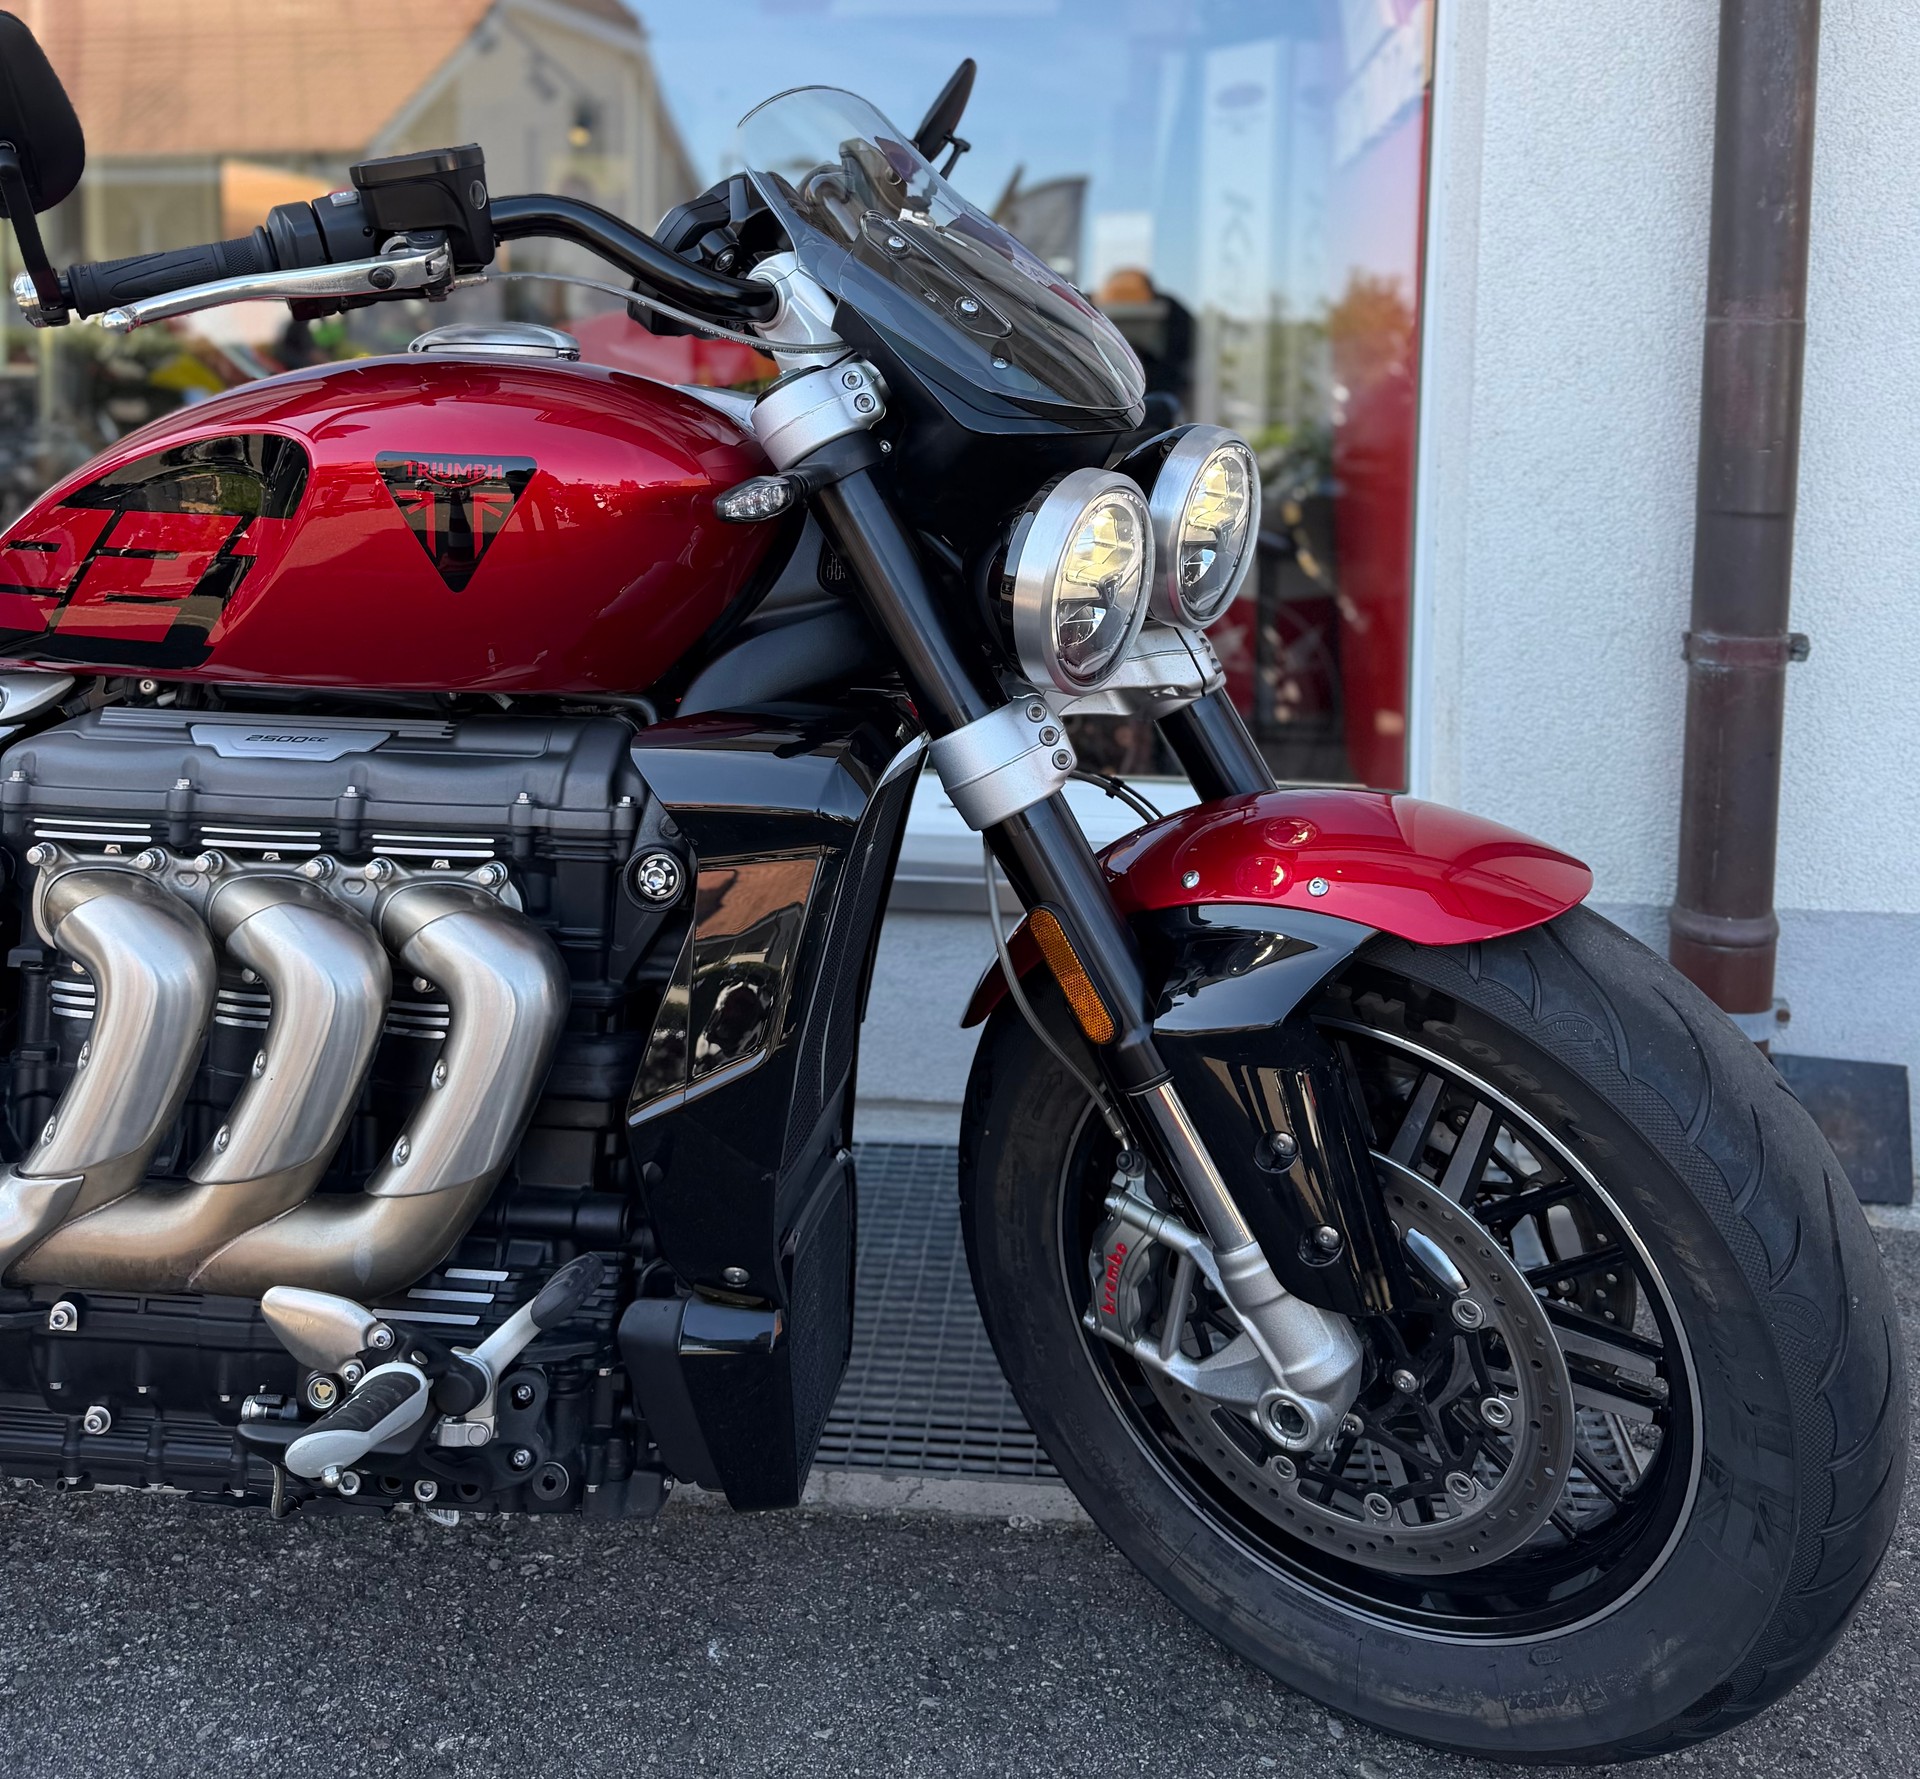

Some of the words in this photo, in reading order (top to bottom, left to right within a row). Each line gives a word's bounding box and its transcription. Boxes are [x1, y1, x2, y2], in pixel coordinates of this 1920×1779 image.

[404, 460, 503, 480] TRIUMPH
[245, 734, 328, 743] 2500cc
[1422, 1019, 1621, 1161] COBRA
[1100, 1242, 1127, 1315] brembo
